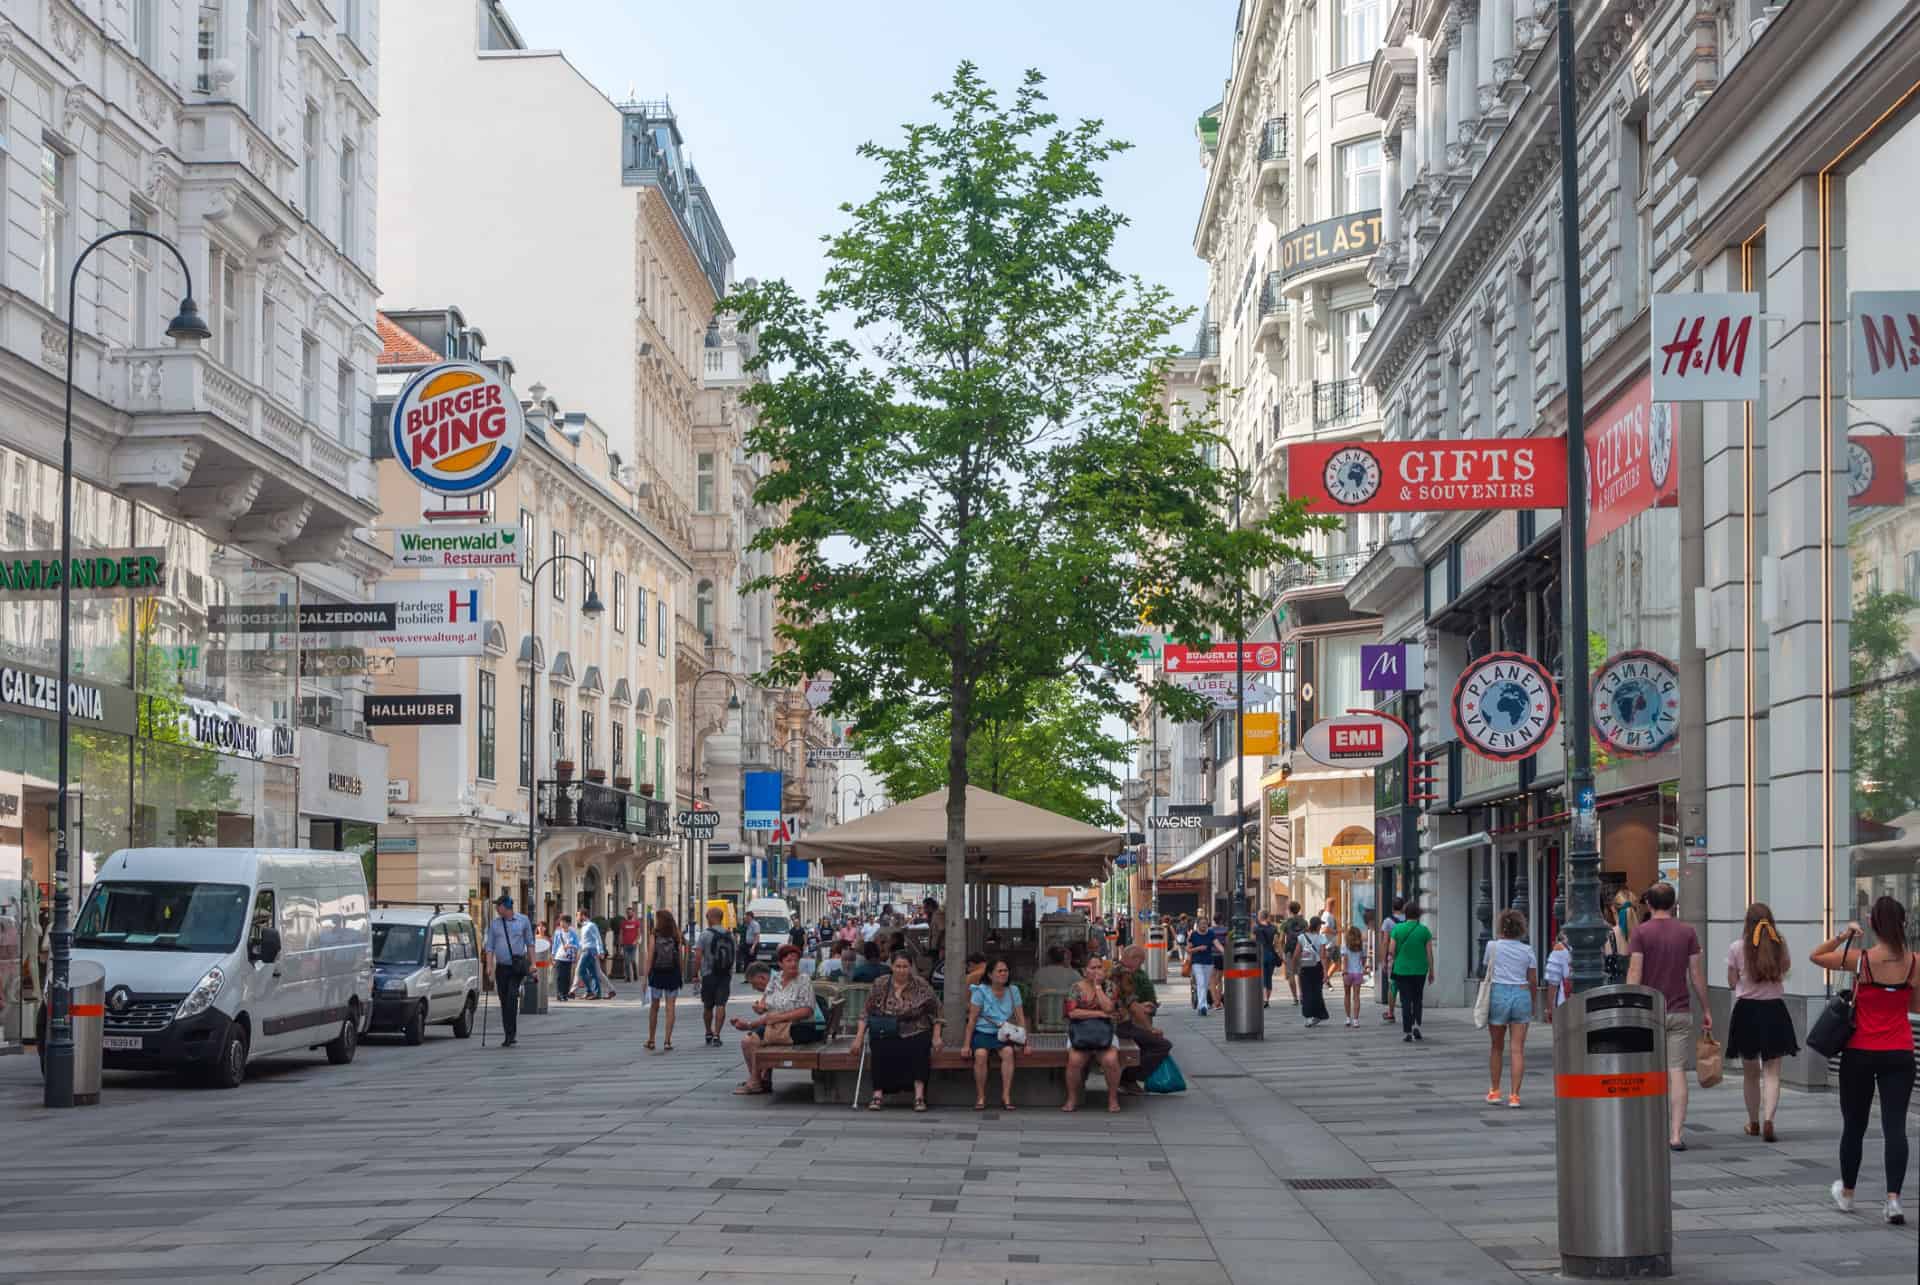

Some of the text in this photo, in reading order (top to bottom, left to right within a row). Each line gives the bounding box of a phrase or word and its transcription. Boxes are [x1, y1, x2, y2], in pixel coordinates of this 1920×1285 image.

[1661, 315, 1753, 377] H&M
[407, 384, 502, 435] BURGER
[411, 406, 507, 469] KING
[1596, 402, 1643, 488] GIFTS
[1330, 452, 1375, 472] PLANET
[1400, 448, 1535, 484] GIFTS
[1401, 483, 1535, 501] & SOUVENIRS
[401, 532, 497, 551] Wienerwald
[443, 551, 517, 564] Restaurant
[299, 611, 388, 625] CALZEDONIA
[379, 632, 478, 644] www.verwaltung.at
[1467, 665, 1544, 696] PLANET
[2, 667, 104, 721] CALZEONIA
[371, 703, 455, 716] HALLHUBER
[1336, 729, 1376, 747] EMI
[1467, 714, 1545, 748] VIENNA
[1150, 816, 1202, 828] WAGNER
